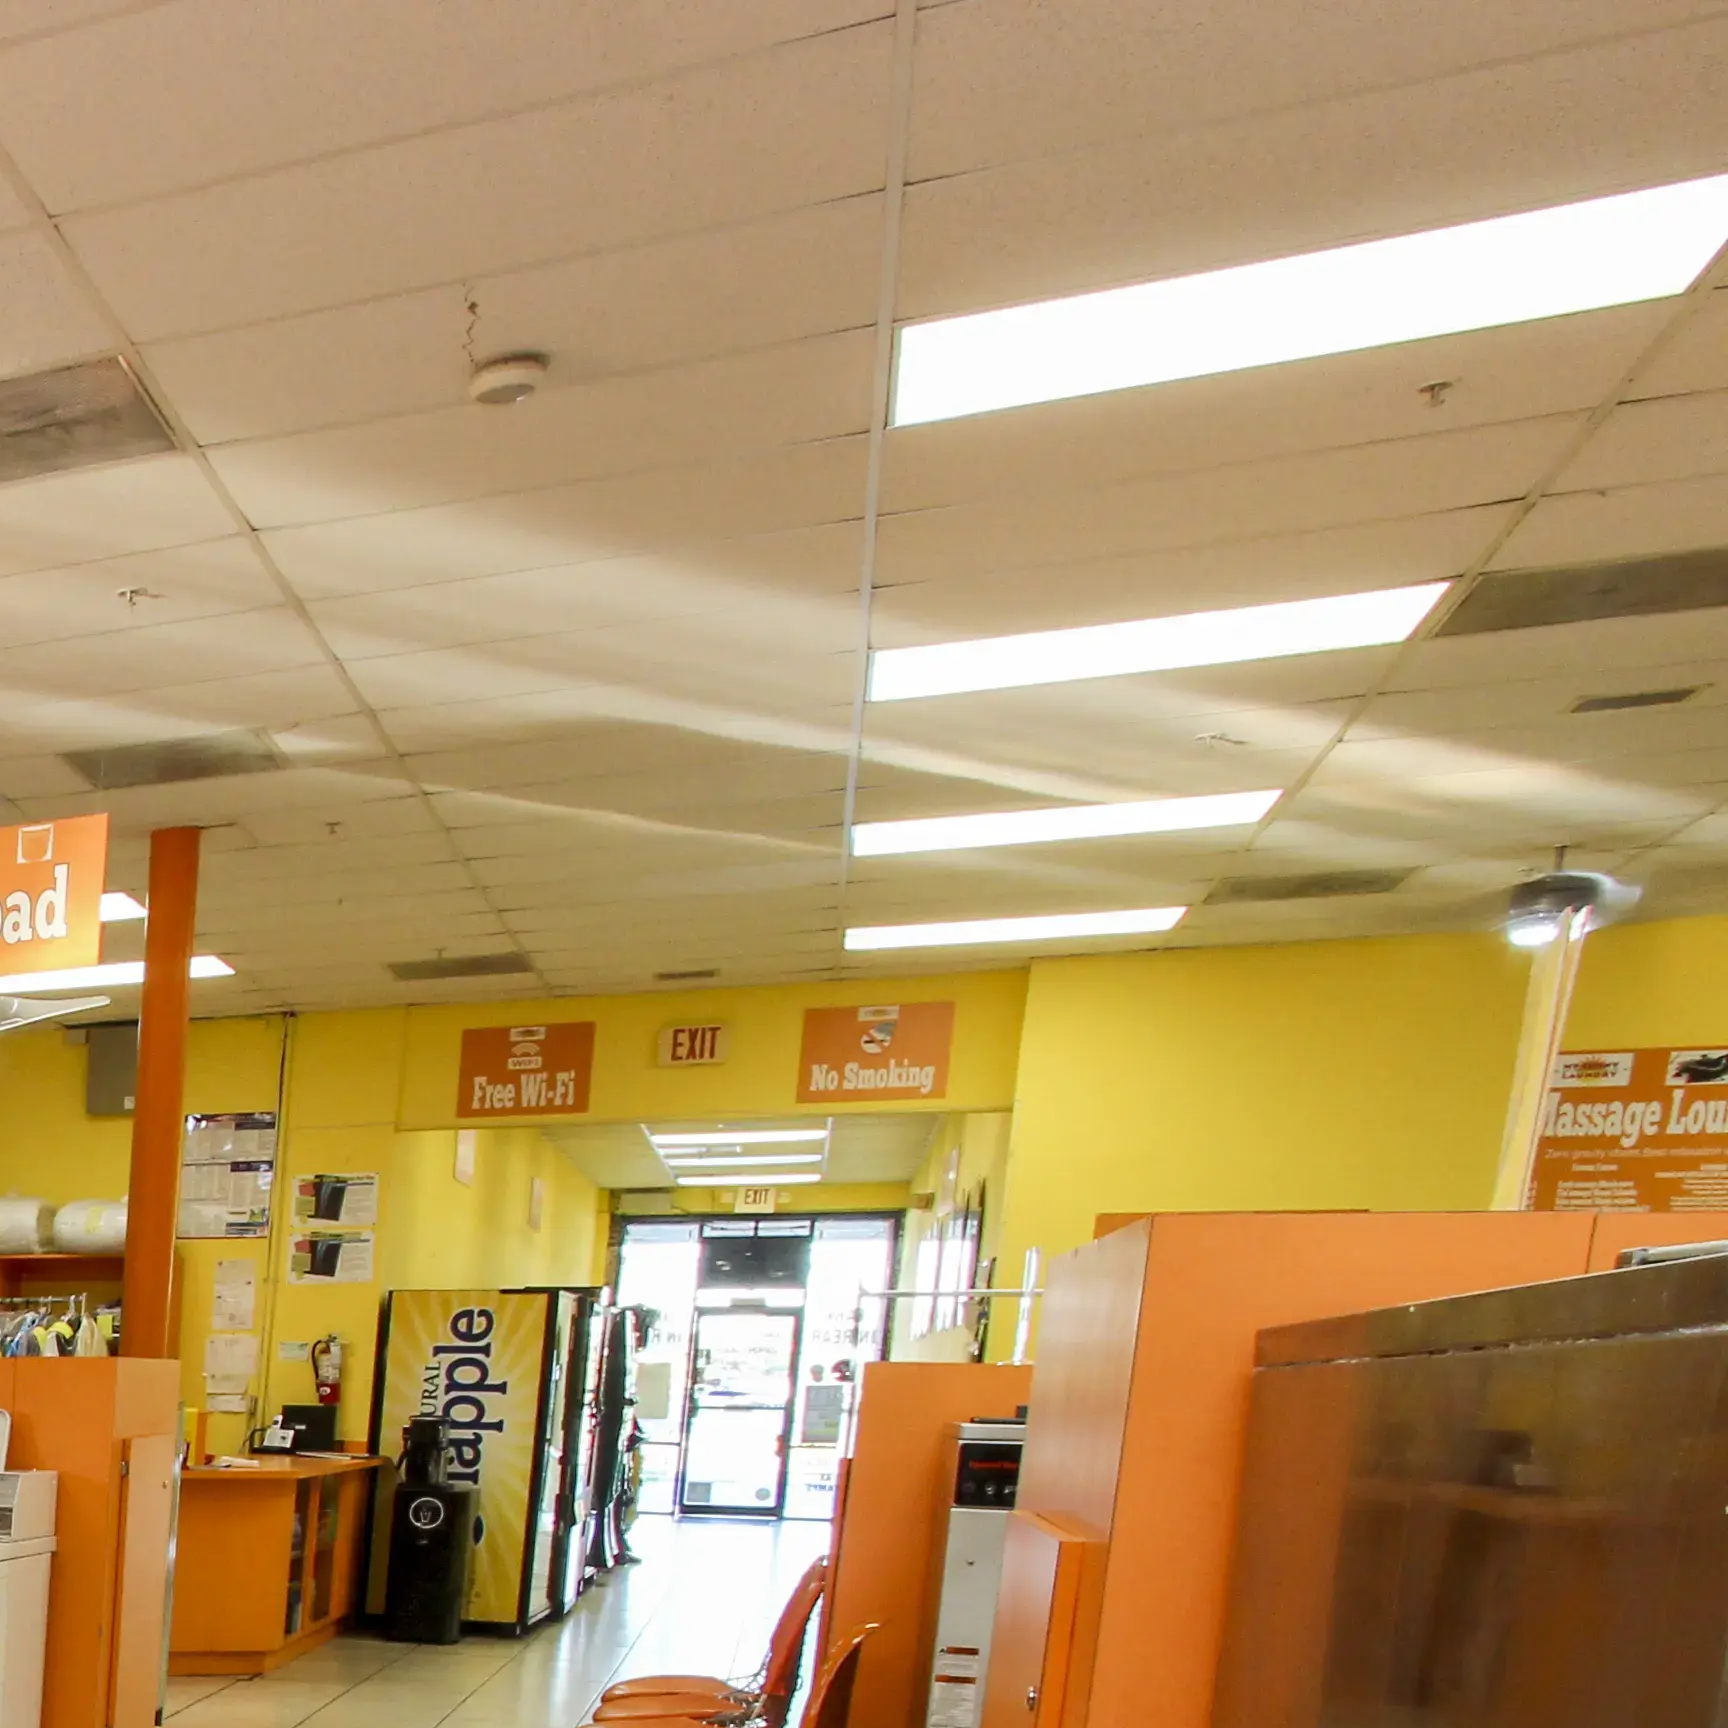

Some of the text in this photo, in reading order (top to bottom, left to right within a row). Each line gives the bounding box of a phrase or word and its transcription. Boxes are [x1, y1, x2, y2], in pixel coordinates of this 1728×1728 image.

[671, 1026, 721, 1061] EXIT
[471, 1070, 575, 1110] Free Wi-Fi
[810, 1058, 935, 1094] No Smoking
[744, 1188, 770, 1205] EXIT
[432, 1307, 508, 1485] apple
